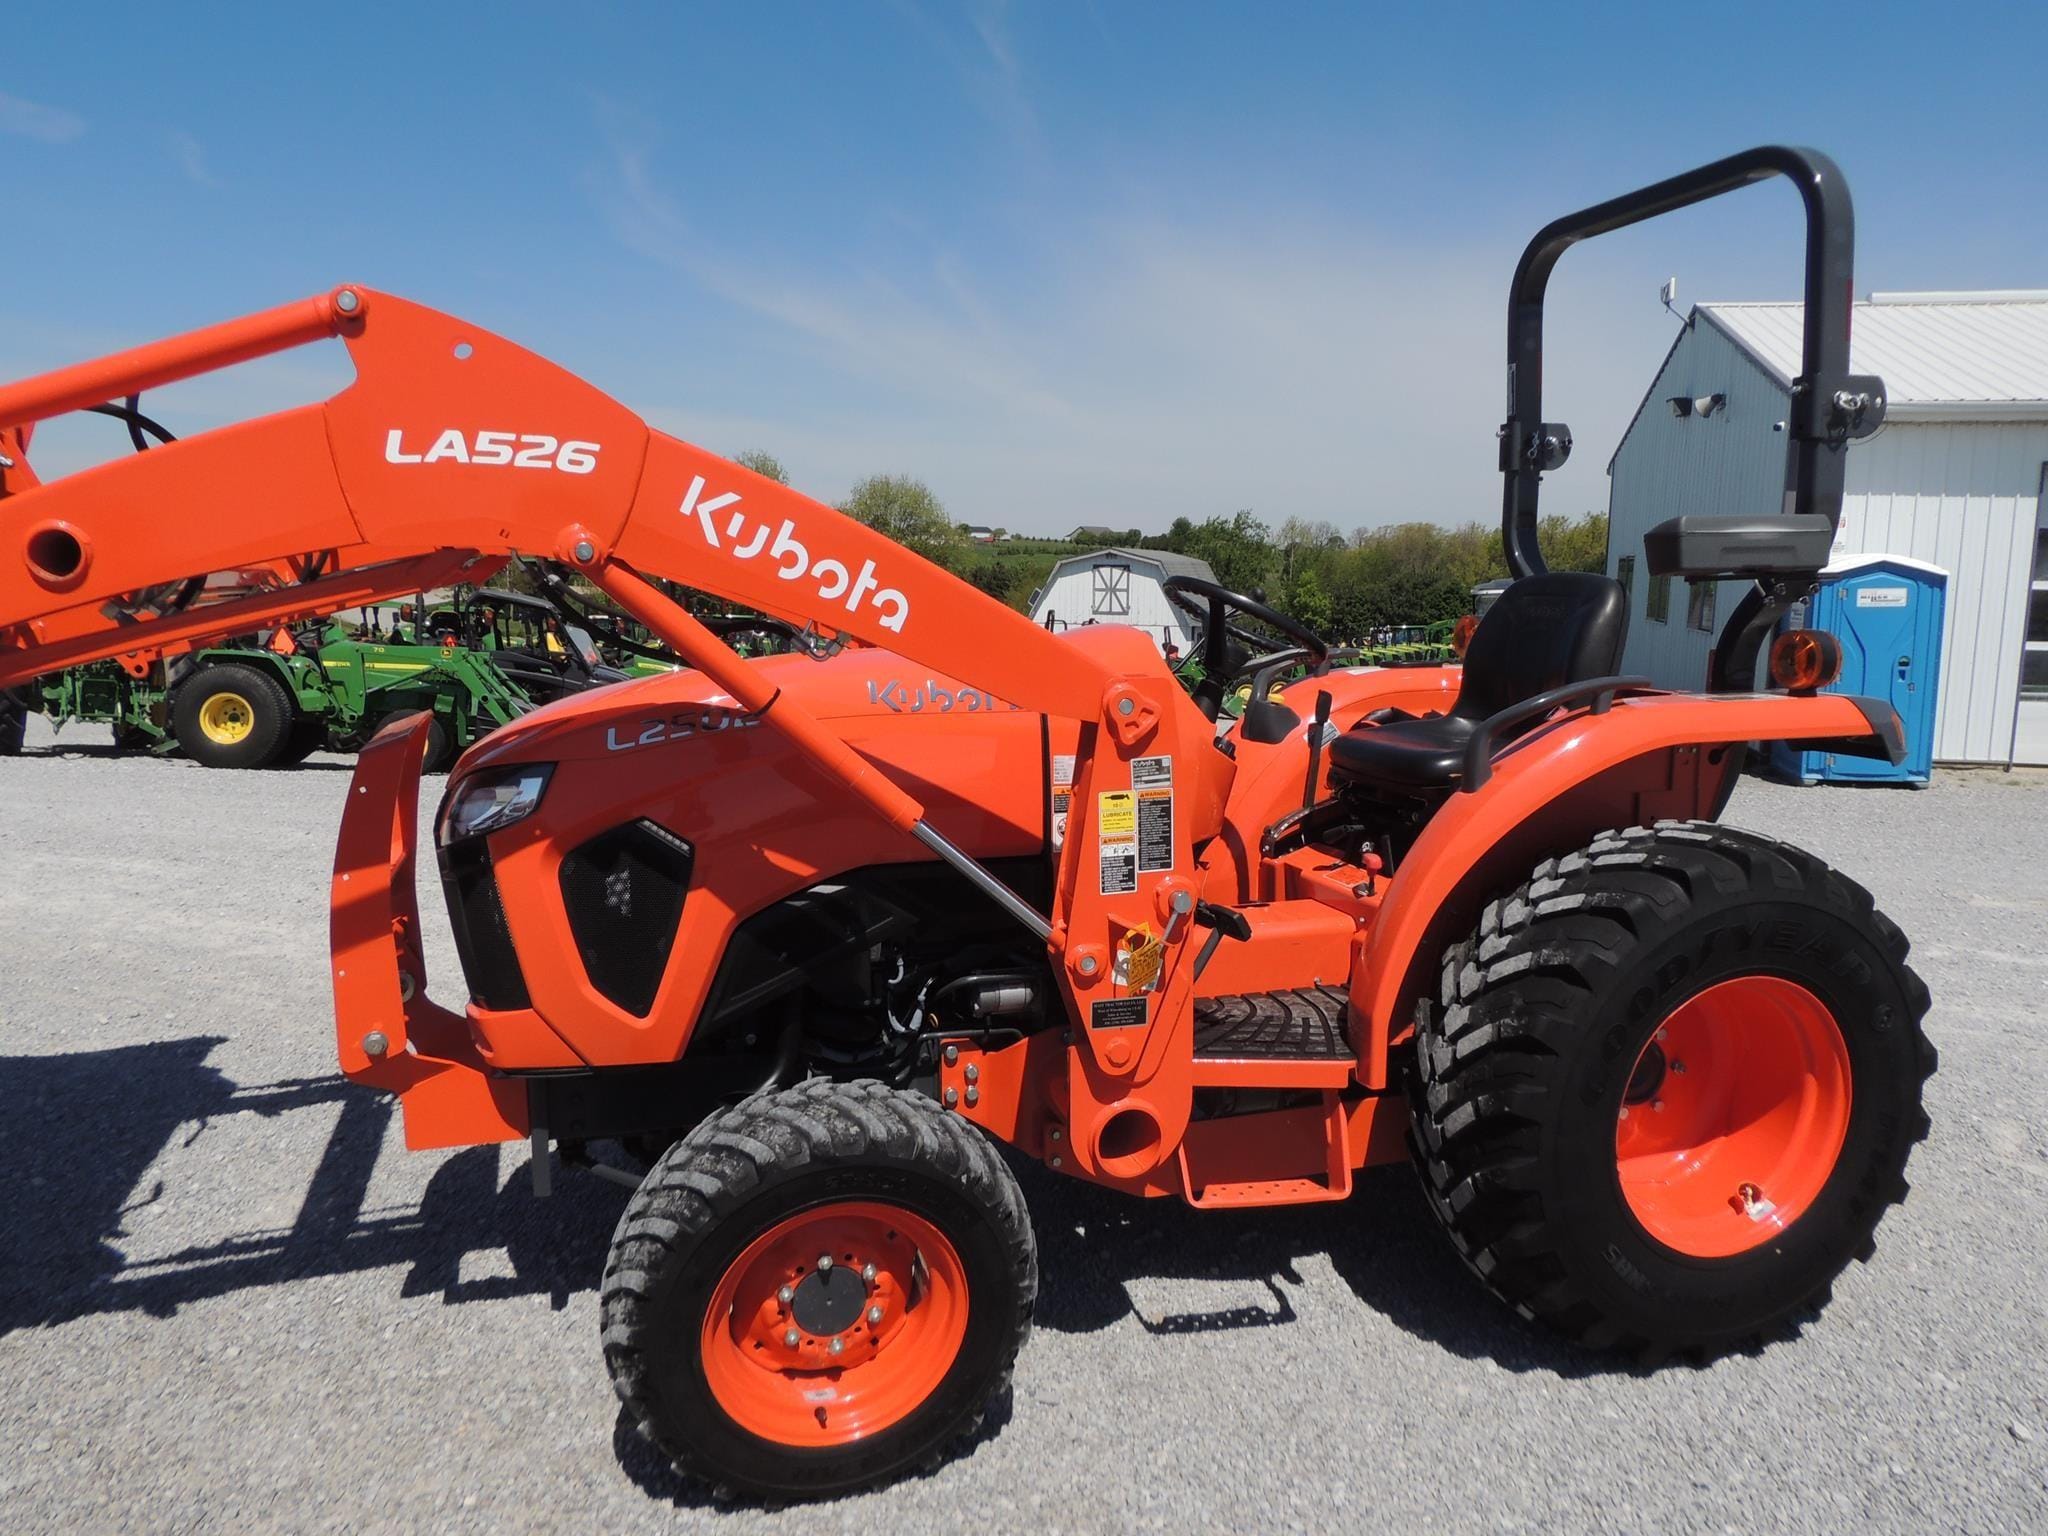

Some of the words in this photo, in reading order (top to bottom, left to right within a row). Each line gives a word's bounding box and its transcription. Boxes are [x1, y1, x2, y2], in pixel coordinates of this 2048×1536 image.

[384, 429, 601, 475] LA526
[679, 475, 910, 633] Kubota
[867, 679, 1017, 713] Kubo
[1579, 920, 1871, 1107] GOODYEAR
